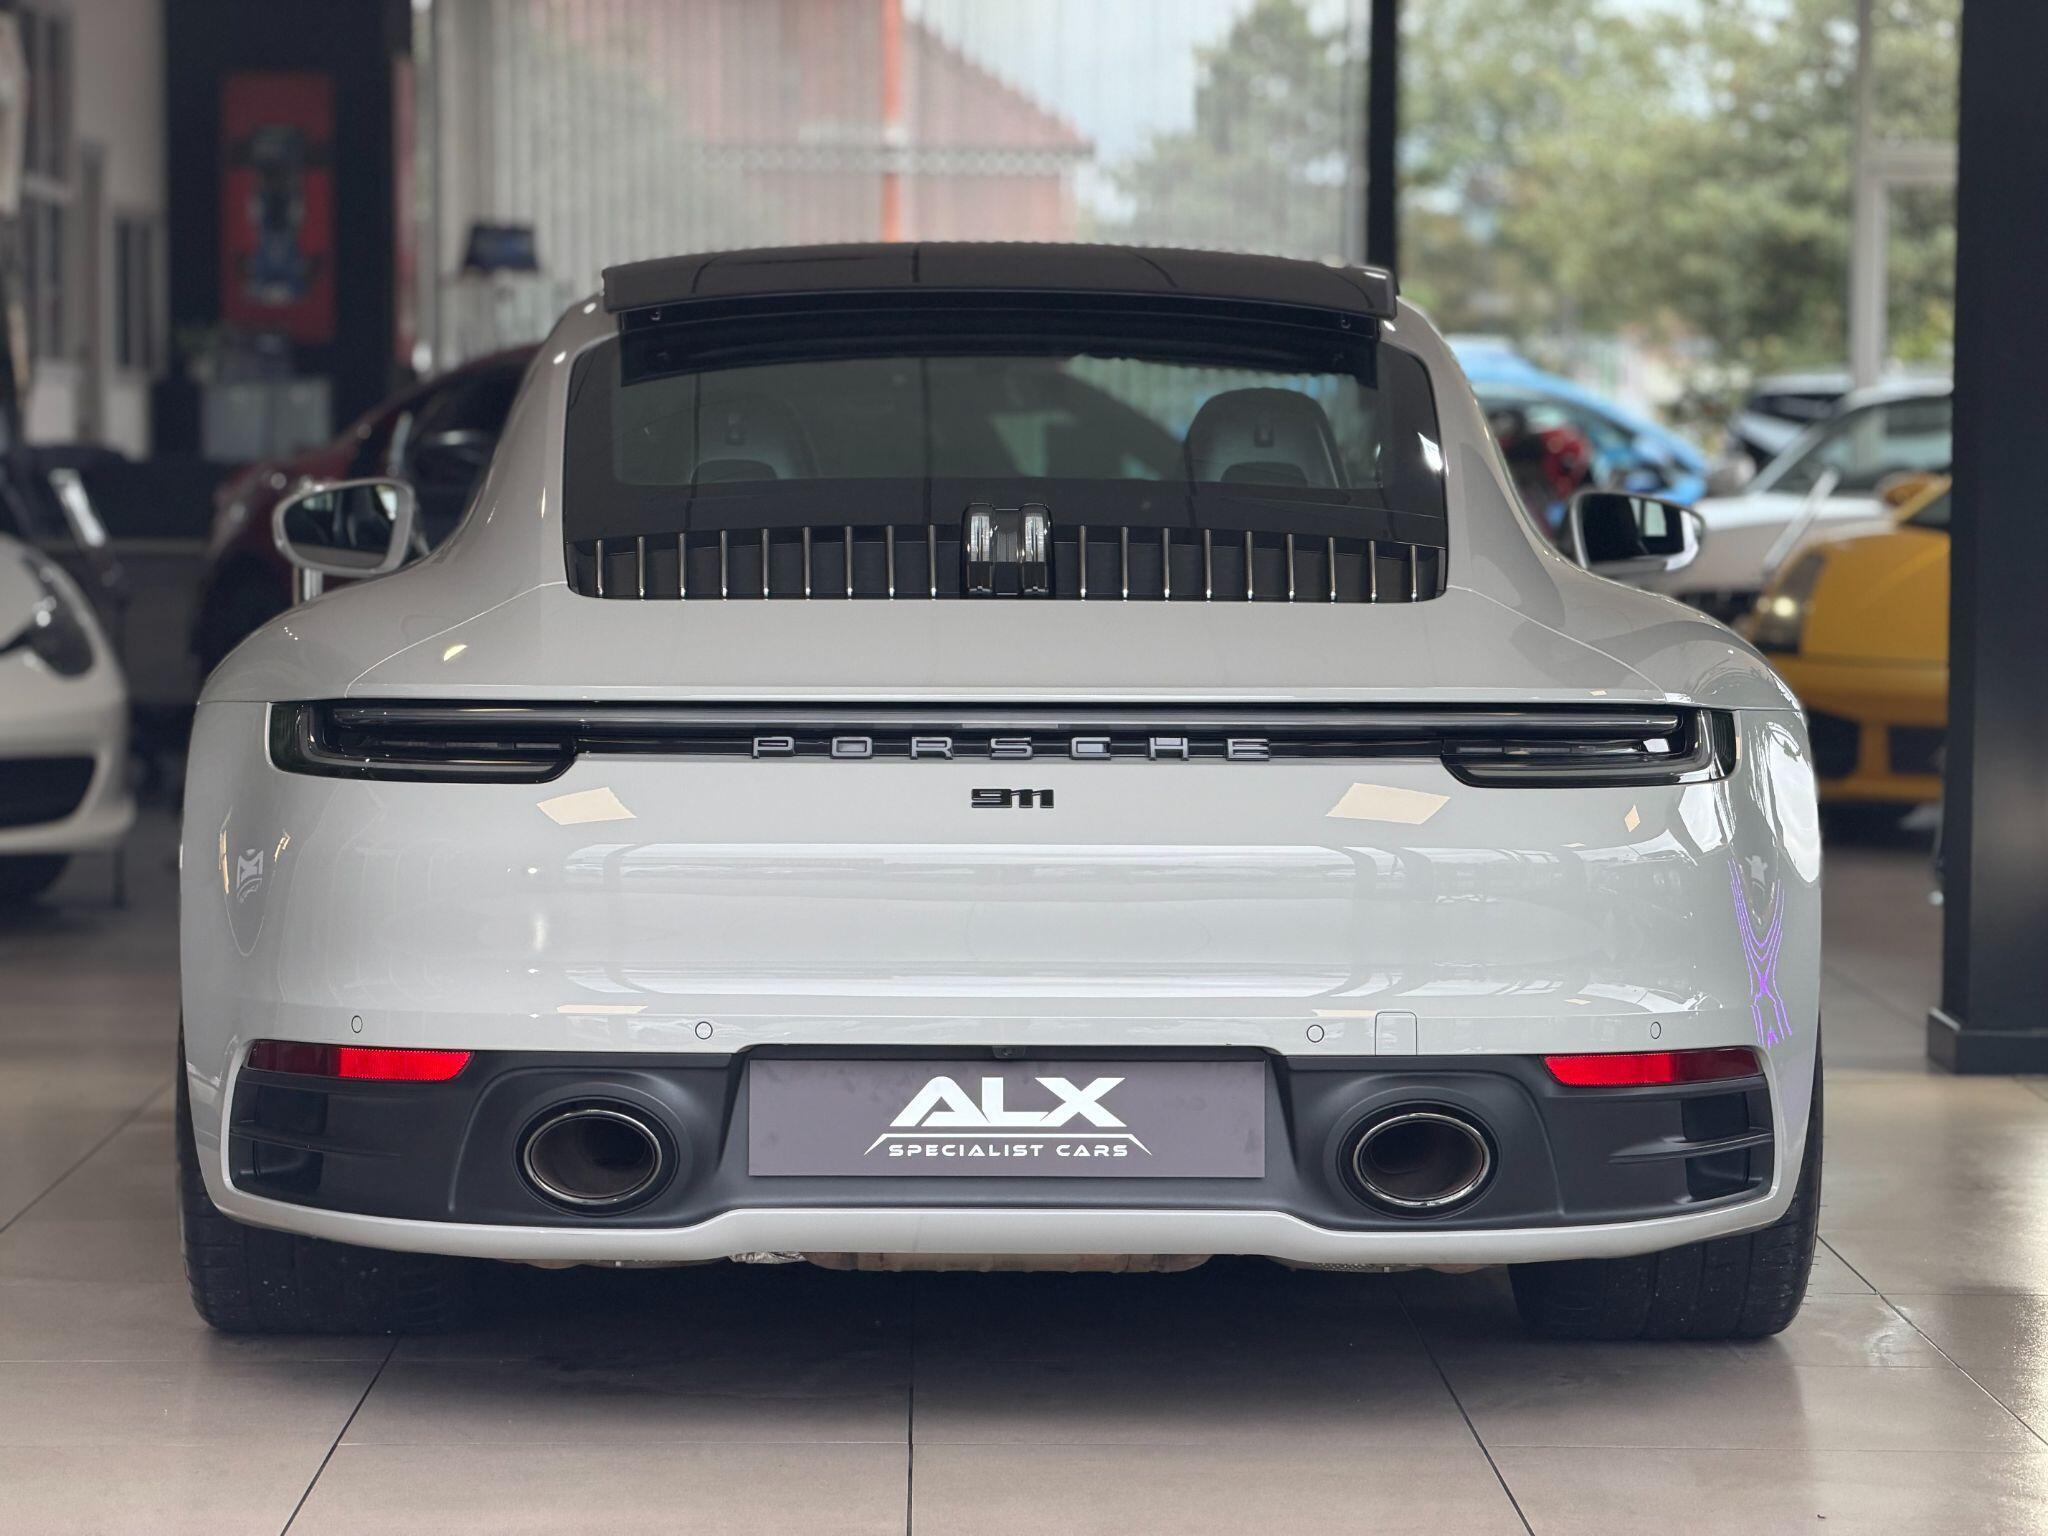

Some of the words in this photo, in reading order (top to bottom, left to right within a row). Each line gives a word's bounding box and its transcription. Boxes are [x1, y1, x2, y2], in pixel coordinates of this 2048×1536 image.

[752, 736, 1270, 760] PORSCHE
[971, 788, 1054, 808] 911
[889, 1076, 1127, 1127] ALX
[888, 1144, 1044, 1157] SPECIALIST
[1055, 1144, 1128, 1157] CARS
